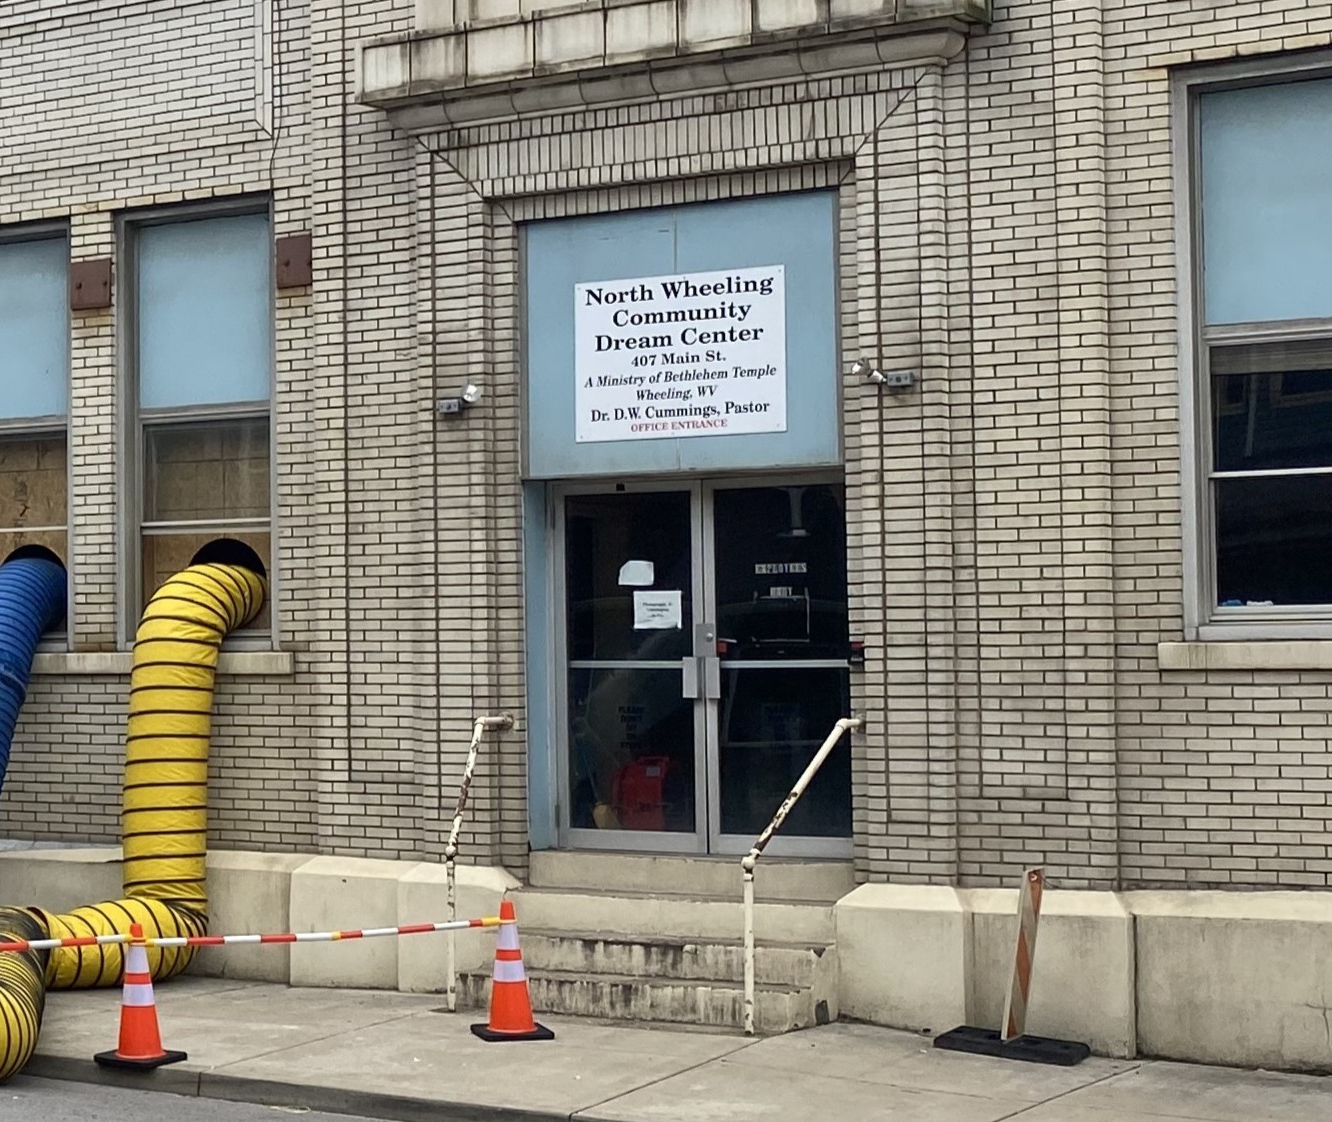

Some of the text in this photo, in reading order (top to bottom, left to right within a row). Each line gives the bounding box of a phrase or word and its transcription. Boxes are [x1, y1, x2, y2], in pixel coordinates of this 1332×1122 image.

[585, 276, 774, 306] North Wheeling
[613, 301, 752, 327] Community
[594, 326, 764, 352] Dream Center
[631, 350, 727, 367] 407 Main St.
[584, 364, 777, 388] A Ministry of Bethlehem Temple
[636, 385, 718, 401] Wheeling, WV
[591, 401, 770, 422] Dr. D.W. Cummings, Pastor
[631, 418, 728, 433] OFFICE ENTRANCE
